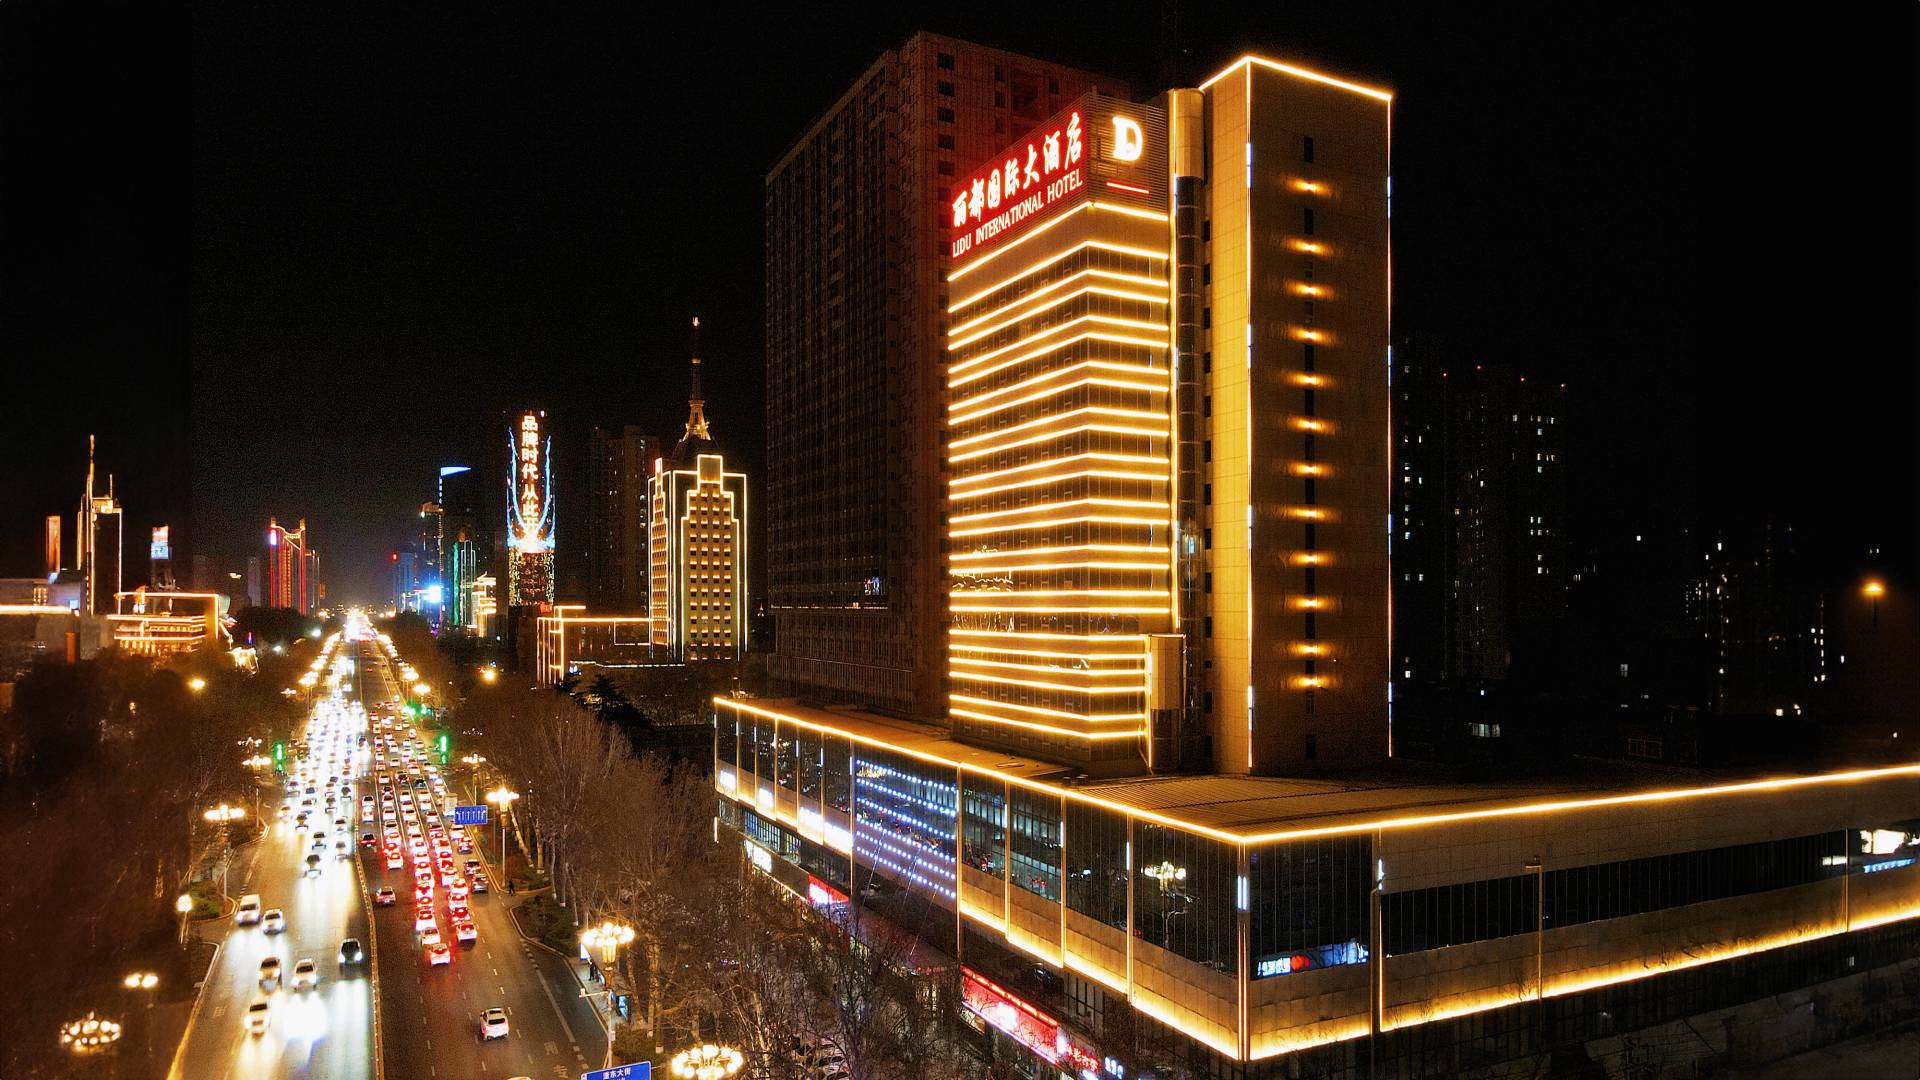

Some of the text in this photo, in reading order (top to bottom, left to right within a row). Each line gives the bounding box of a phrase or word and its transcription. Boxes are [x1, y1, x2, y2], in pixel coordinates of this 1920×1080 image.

[952, 112, 1082, 228] 丽都国际大酒店
[1113, 116, 1143, 161] D
[952, 168, 1083, 258] LIDU INTERNATIONAL HOTEL
[521, 415, 539, 479] 品牌时代
